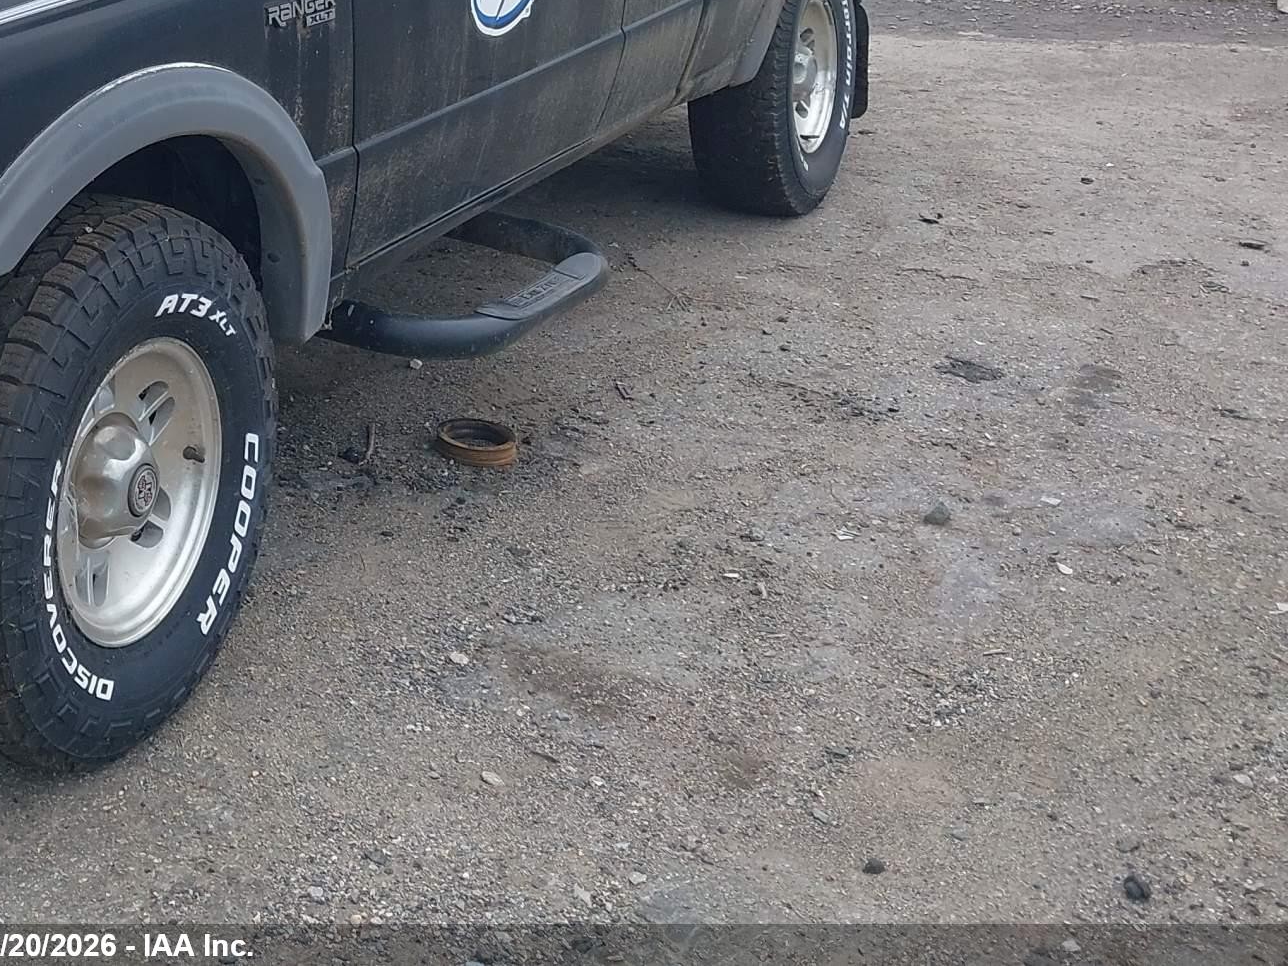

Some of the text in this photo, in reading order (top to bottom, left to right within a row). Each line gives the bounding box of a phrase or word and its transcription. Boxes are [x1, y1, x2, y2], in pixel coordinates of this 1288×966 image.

[154, 293, 237, 336] AT3 XLT
[43, 458, 115, 702] DISCOVERER
[196, 432, 260, 636] COOPER
